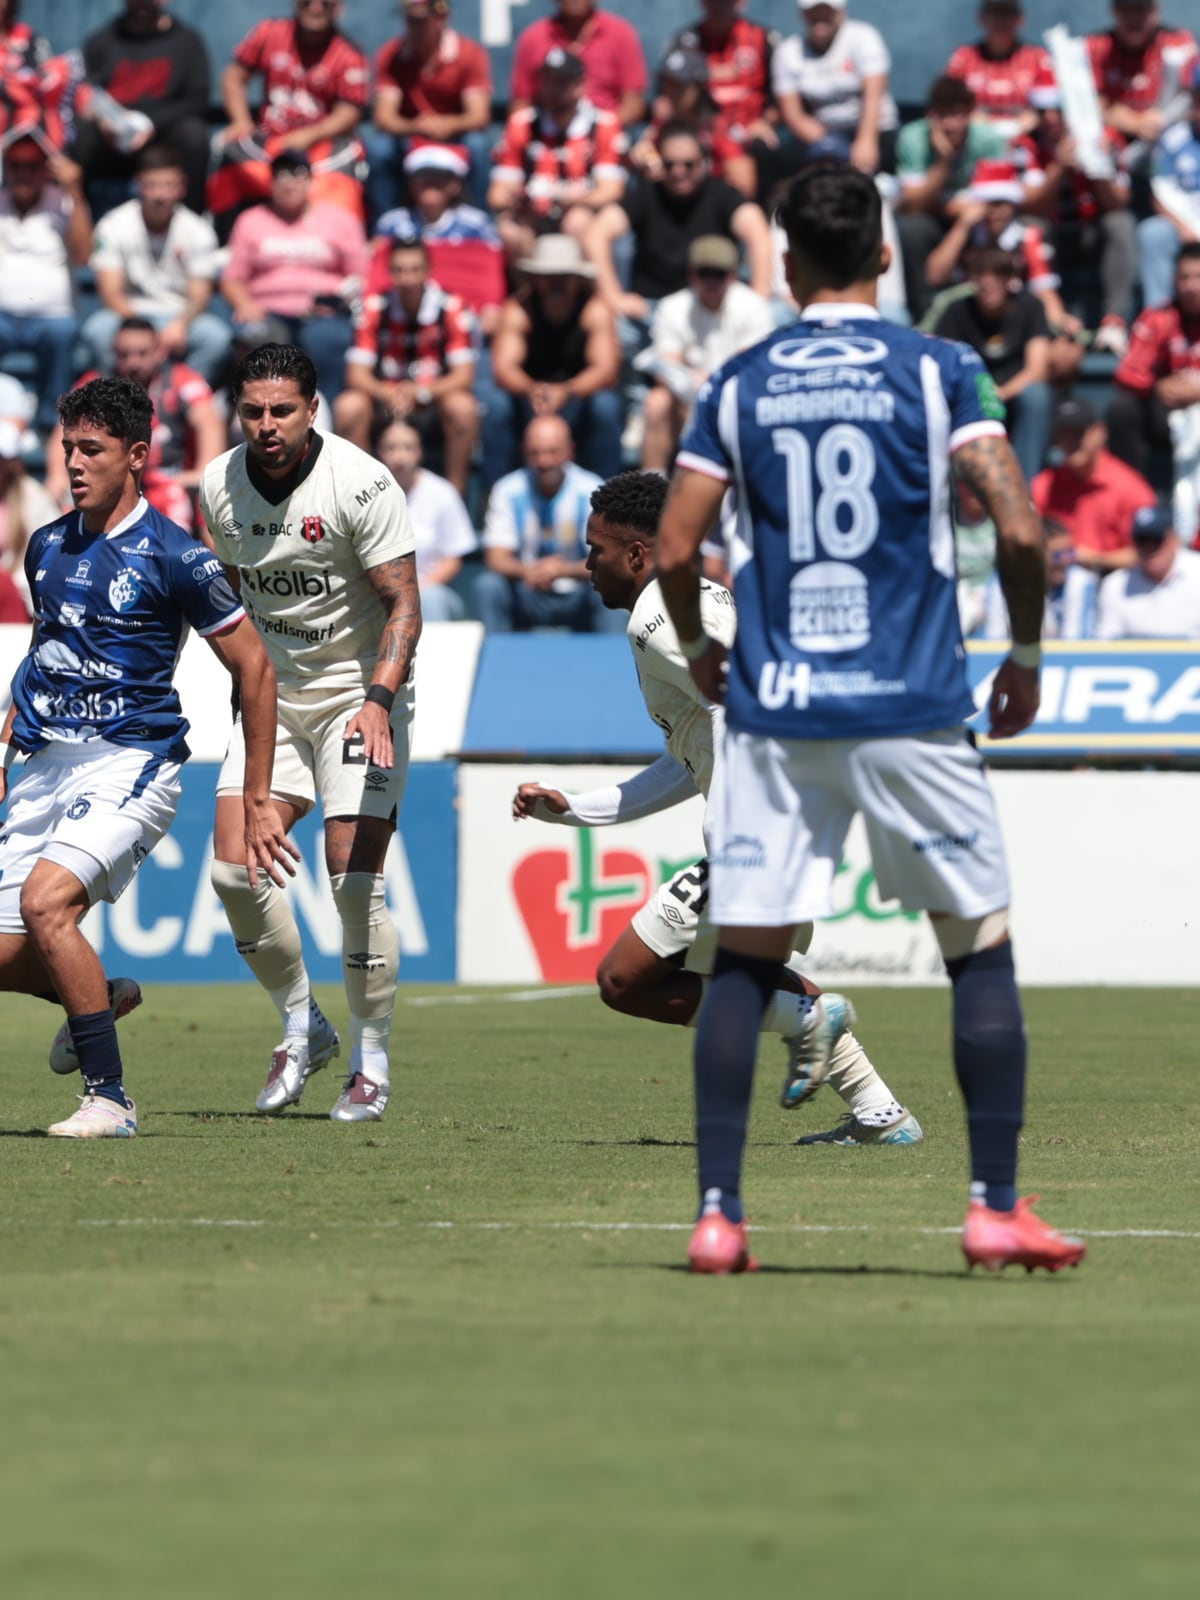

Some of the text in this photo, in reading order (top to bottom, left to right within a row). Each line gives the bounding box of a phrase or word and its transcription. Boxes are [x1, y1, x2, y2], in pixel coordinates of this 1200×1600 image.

[766, 366, 884, 393] CHERY
[355, 475, 392, 507] Mobil
[772, 423, 880, 562] 18
[269, 522, 293, 536] BAC
[256, 569, 332, 597] kölbi
[635, 613, 666, 652] Mobil
[789, 606, 871, 635] KING
[81, 659, 124, 680] INS
[54, 690, 127, 720] kölbi
